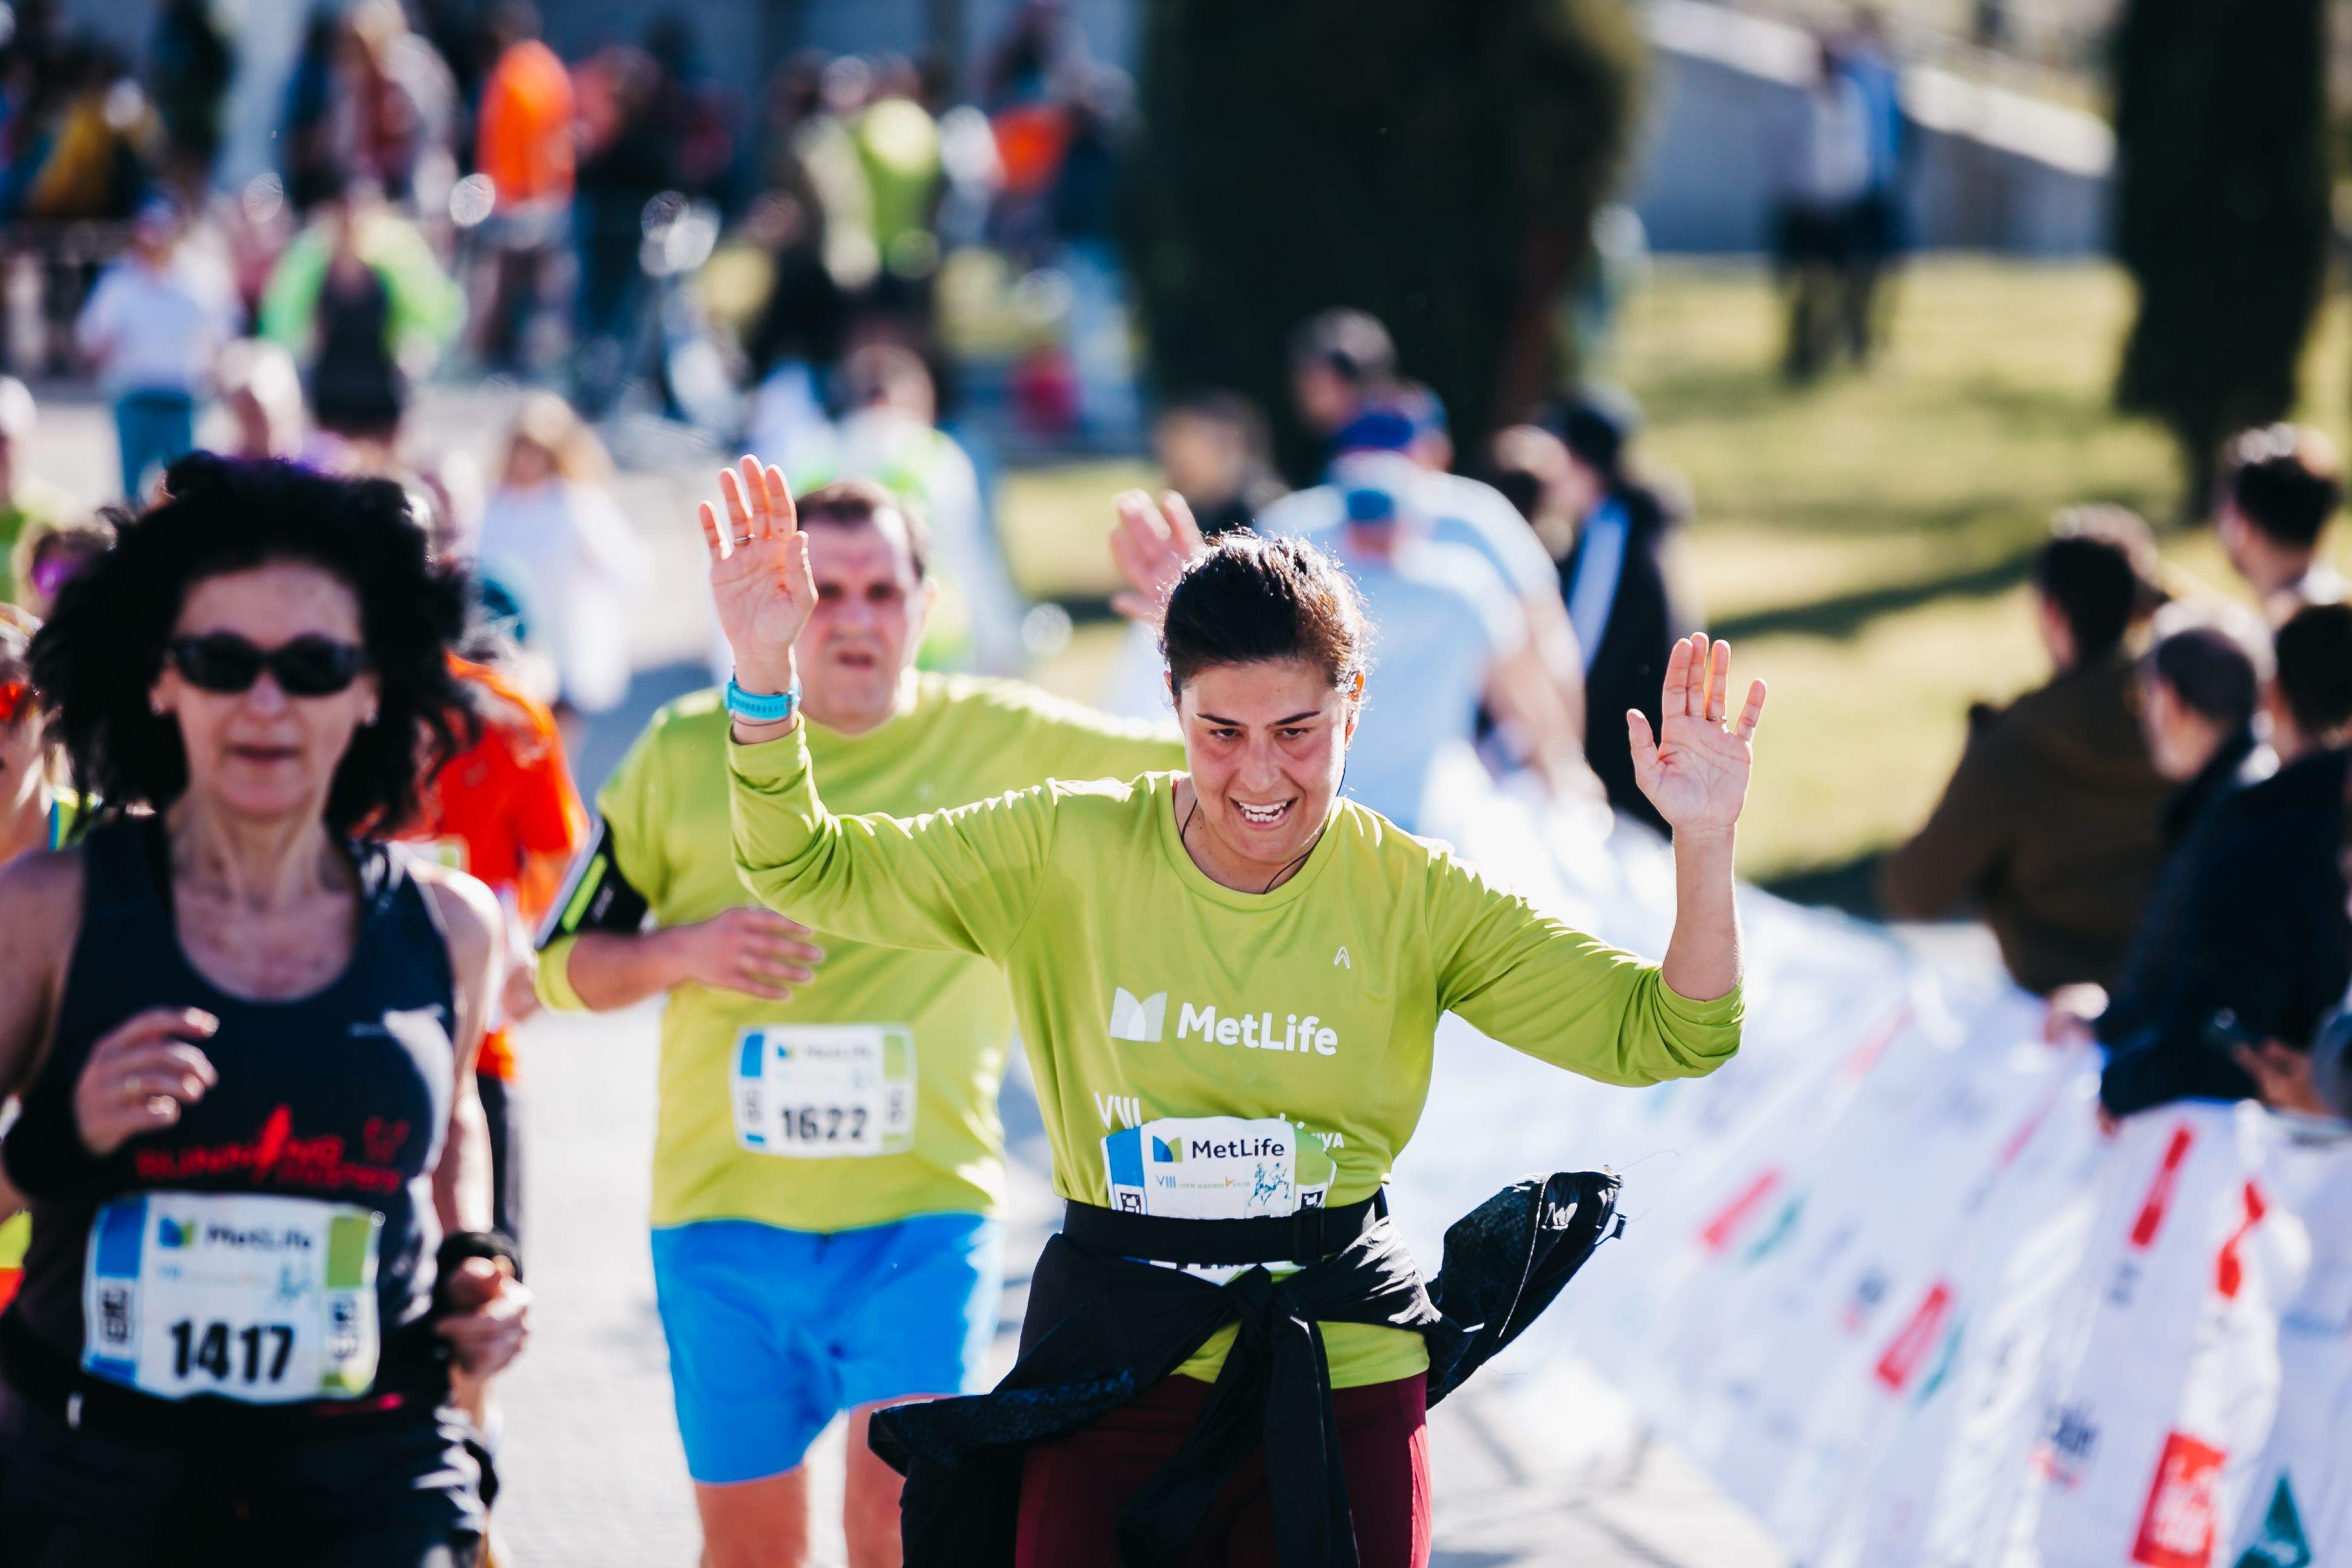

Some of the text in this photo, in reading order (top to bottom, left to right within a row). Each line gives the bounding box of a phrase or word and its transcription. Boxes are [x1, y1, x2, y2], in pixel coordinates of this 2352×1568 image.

[1177, 1002, 1338, 1057] MetLife
[1094, 1091, 1143, 1130] VIII
[1192, 1138, 1285, 1159] MetLife
[1155, 1174, 1176, 1189] VIII
[169, 1319, 295, 1385] 1417
